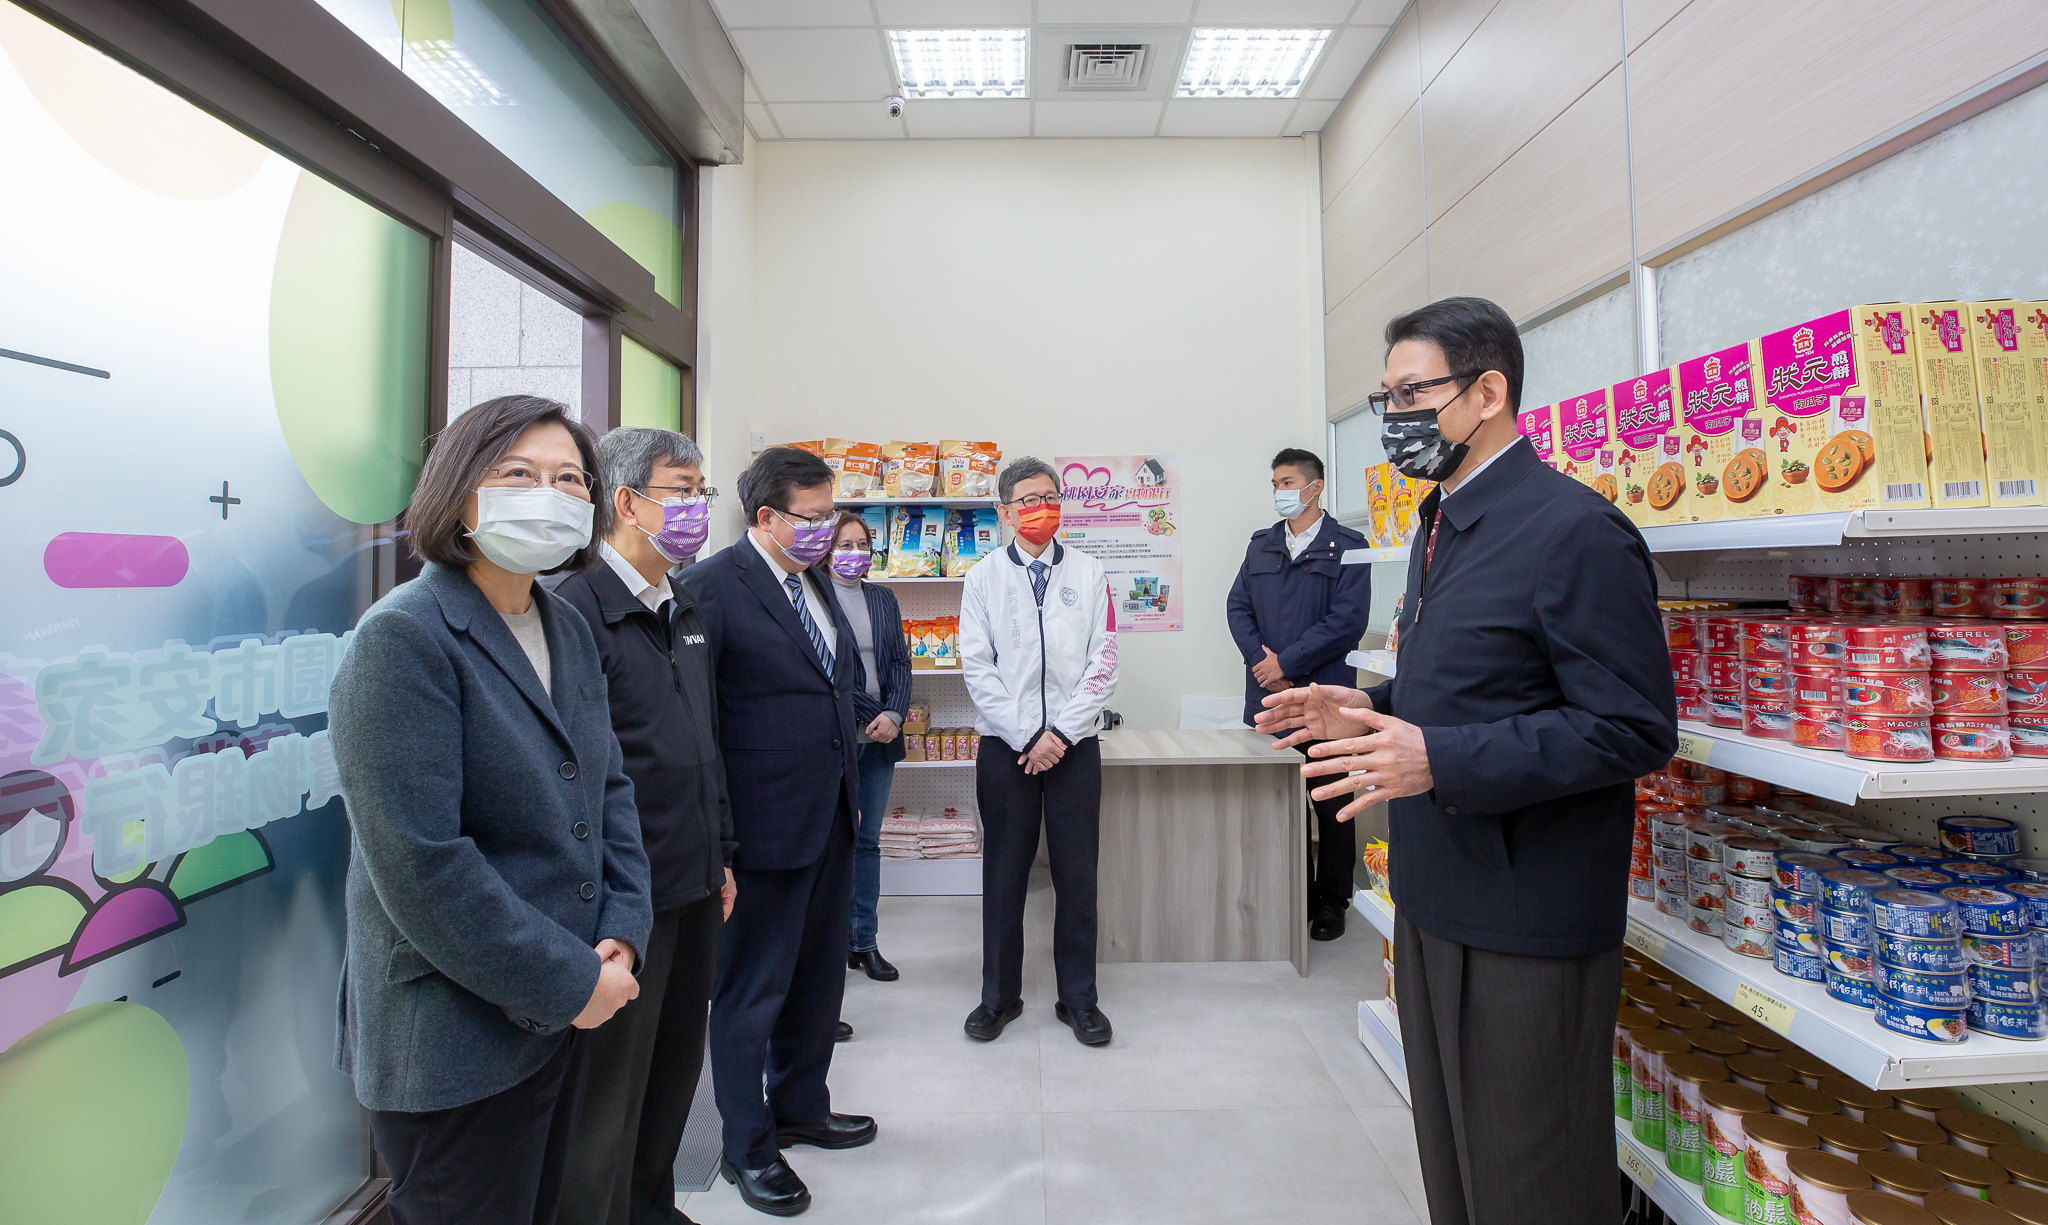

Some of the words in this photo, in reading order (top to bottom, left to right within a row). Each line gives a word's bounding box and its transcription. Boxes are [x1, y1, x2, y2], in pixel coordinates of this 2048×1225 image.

[1767, 356, 1832, 397] 狀元
[1684, 383, 1736, 418] 狀元
[1617, 403, 1659, 434] 狀元
[1562, 420, 1597, 446] 狀元
[1678, 743, 1690, 753] 35
[1751, 1004, 1764, 1018] 45
[1626, 1155, 1640, 1172] 165
